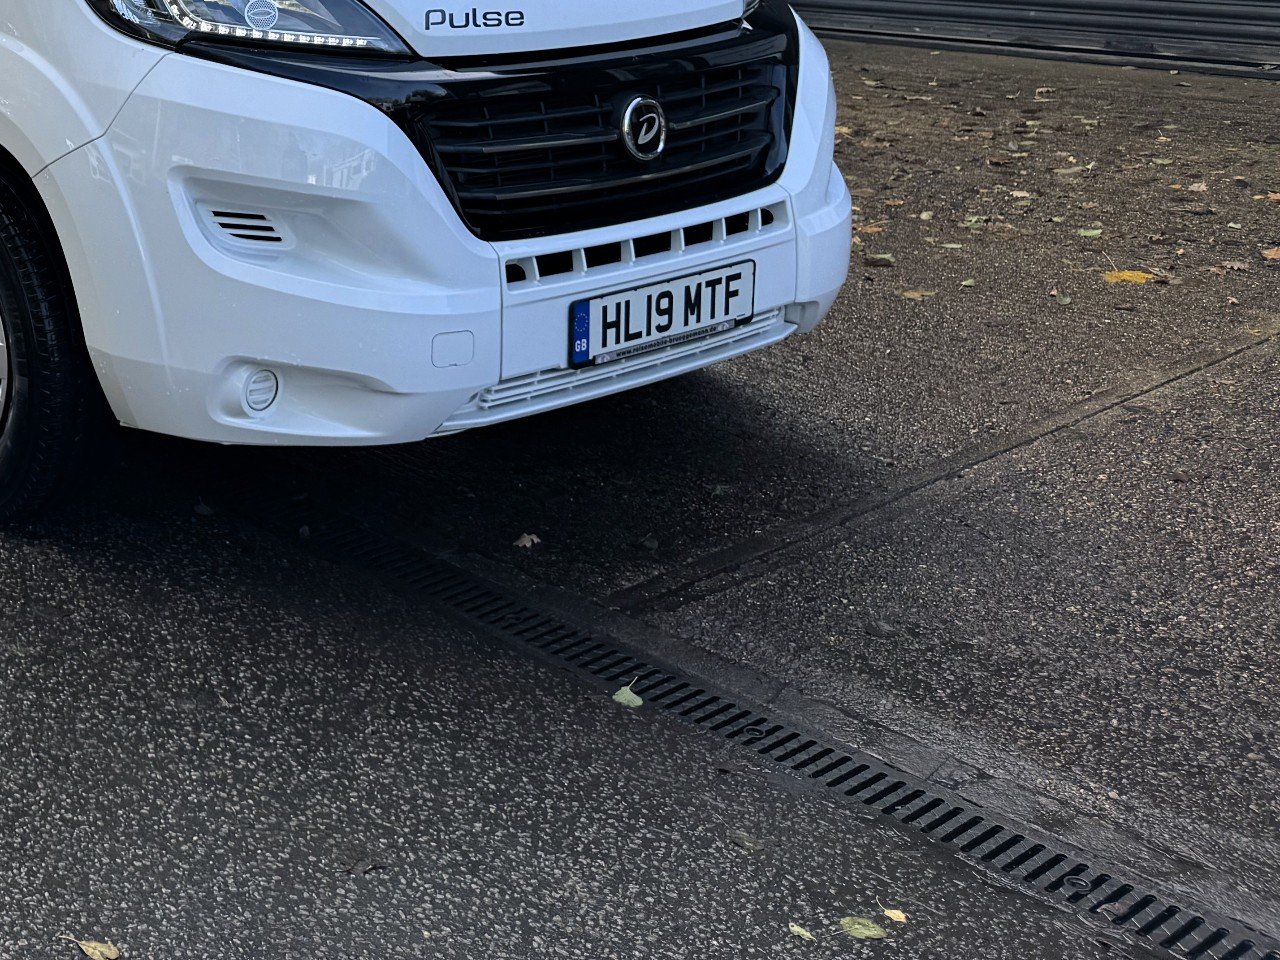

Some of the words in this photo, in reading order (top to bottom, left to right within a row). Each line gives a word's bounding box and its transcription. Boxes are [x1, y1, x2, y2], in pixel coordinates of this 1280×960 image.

[425, 7, 525, 30] Pulse
[601, 290, 674, 348] HL19
[683, 272, 742, 327] MTF
[574, 338, 588, 352] GB
